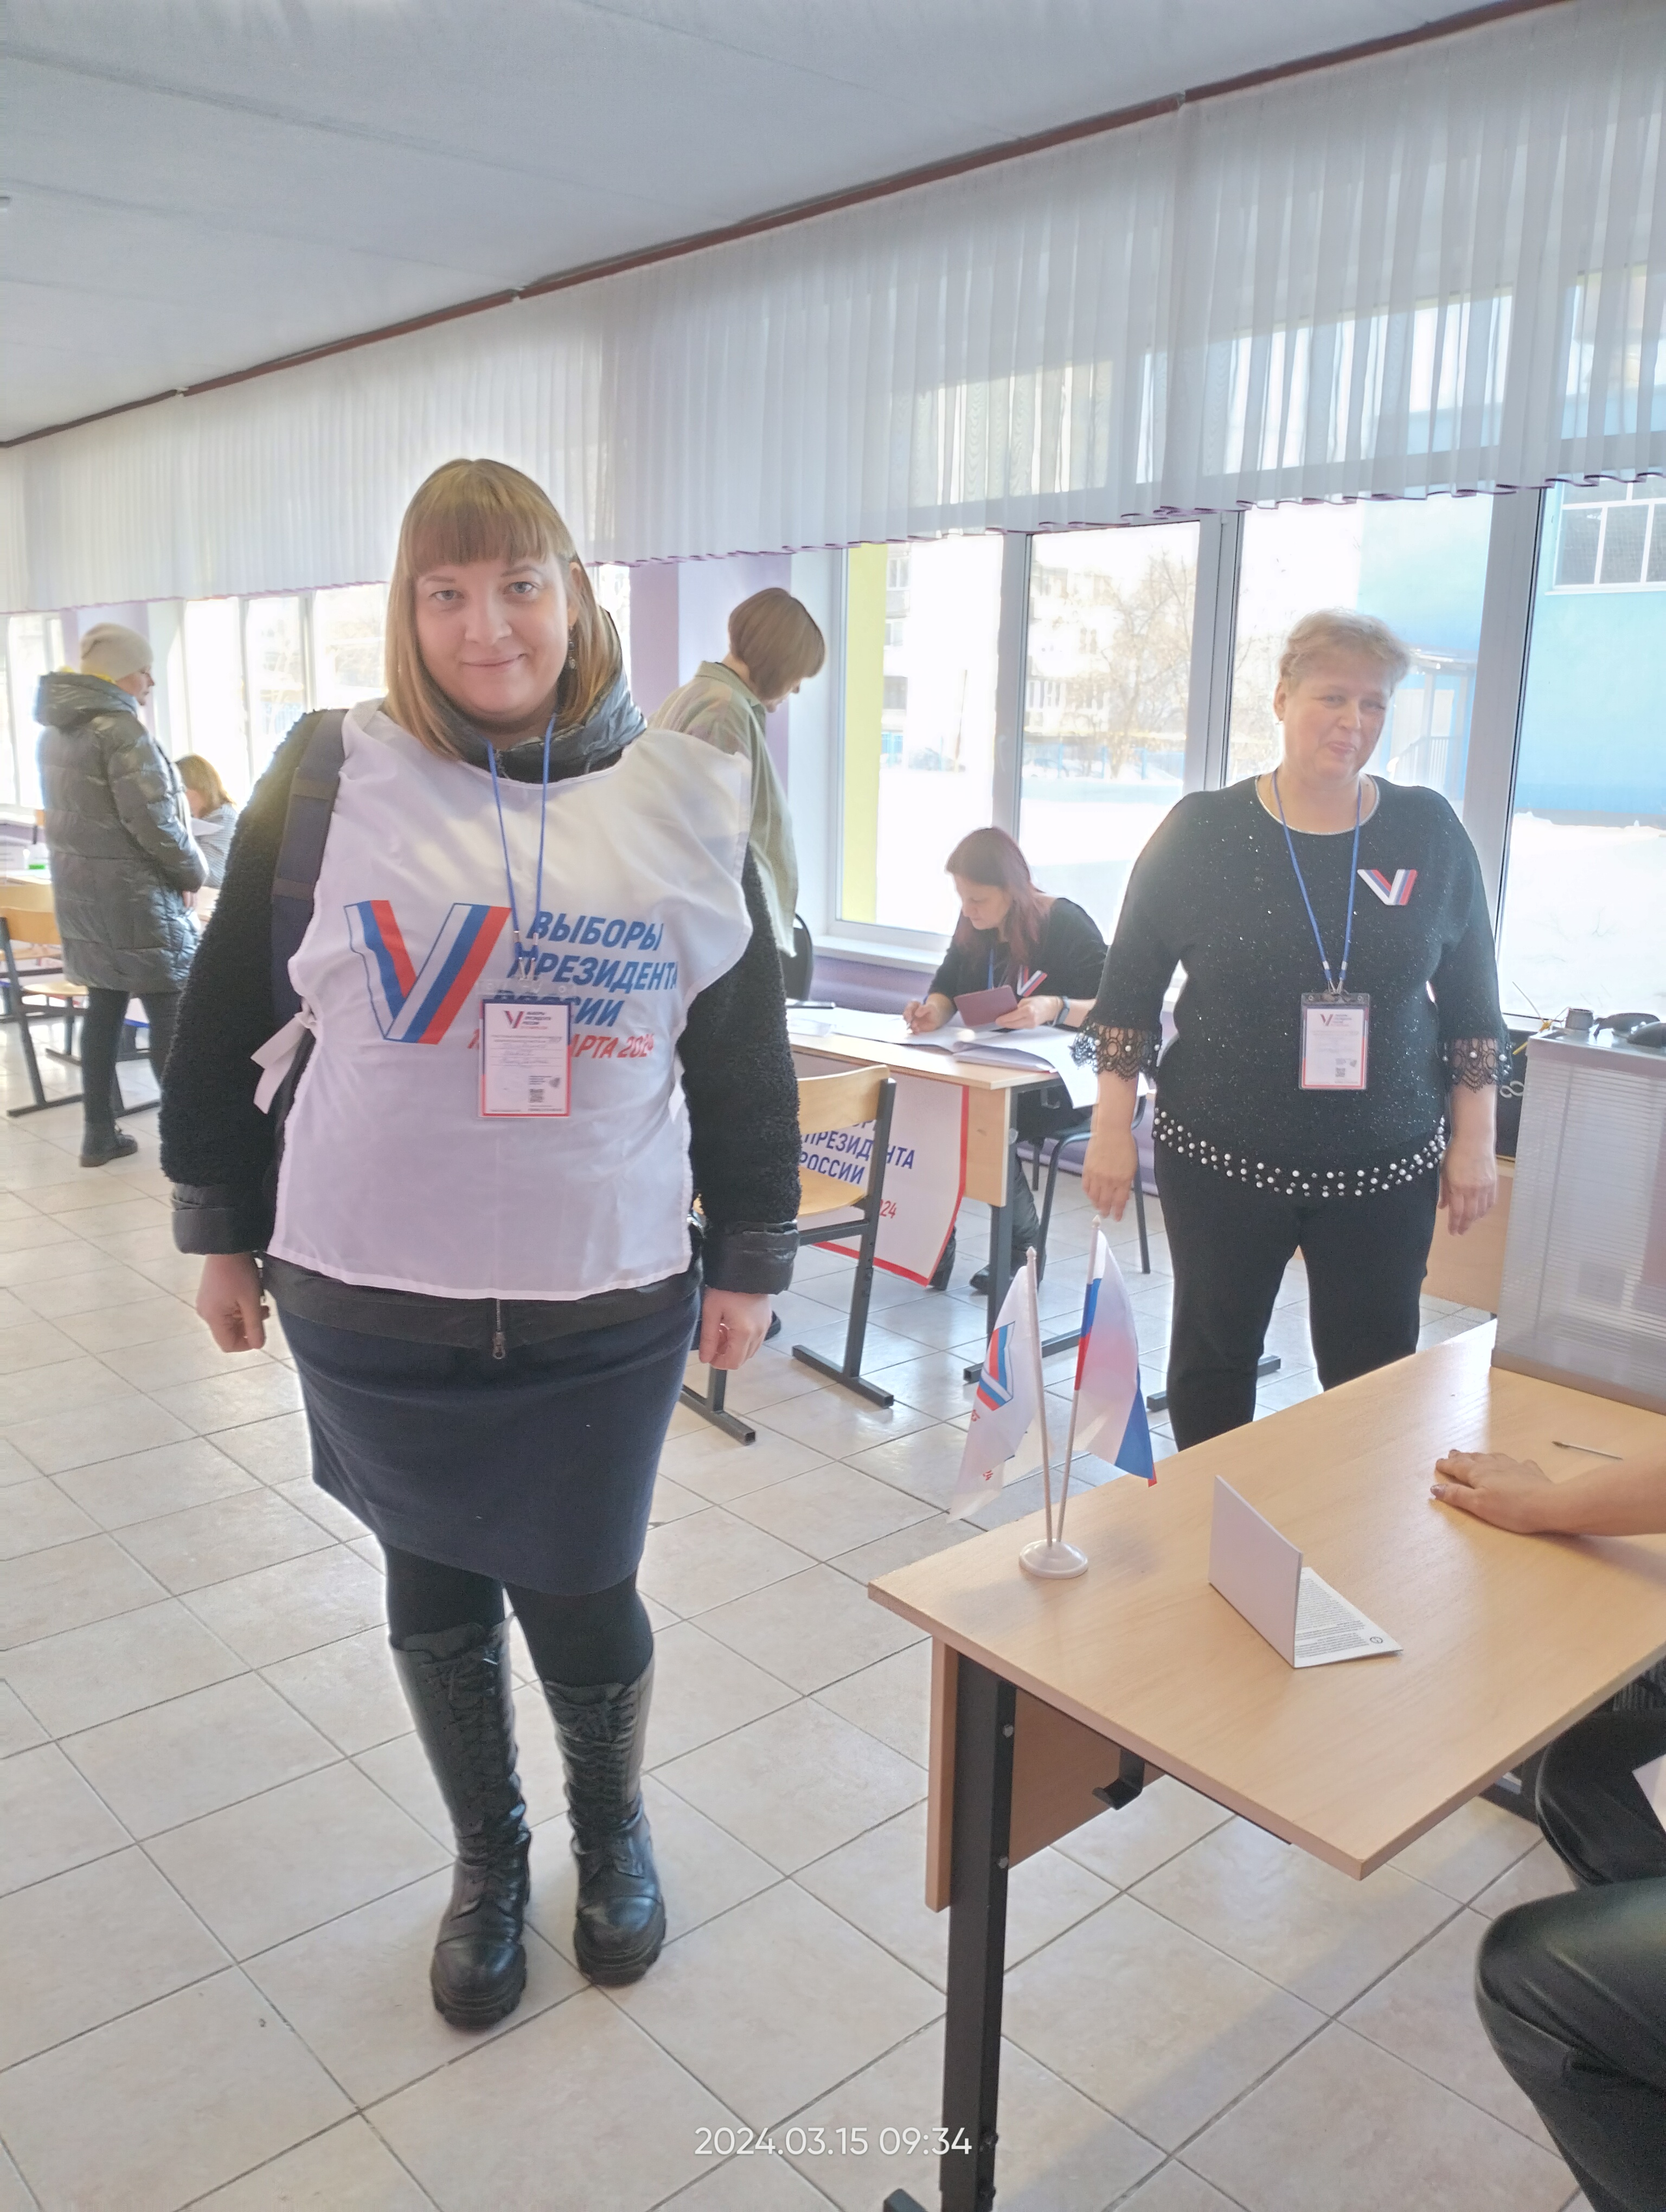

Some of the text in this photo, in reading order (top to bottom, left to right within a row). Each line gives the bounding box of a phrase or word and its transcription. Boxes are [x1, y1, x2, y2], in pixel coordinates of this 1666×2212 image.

[526, 911, 663, 950] ВЫБОРЫ
[571, 1033, 618, 1058] РТА
[804, 1130, 915, 1169] РЕЗИДНТА
